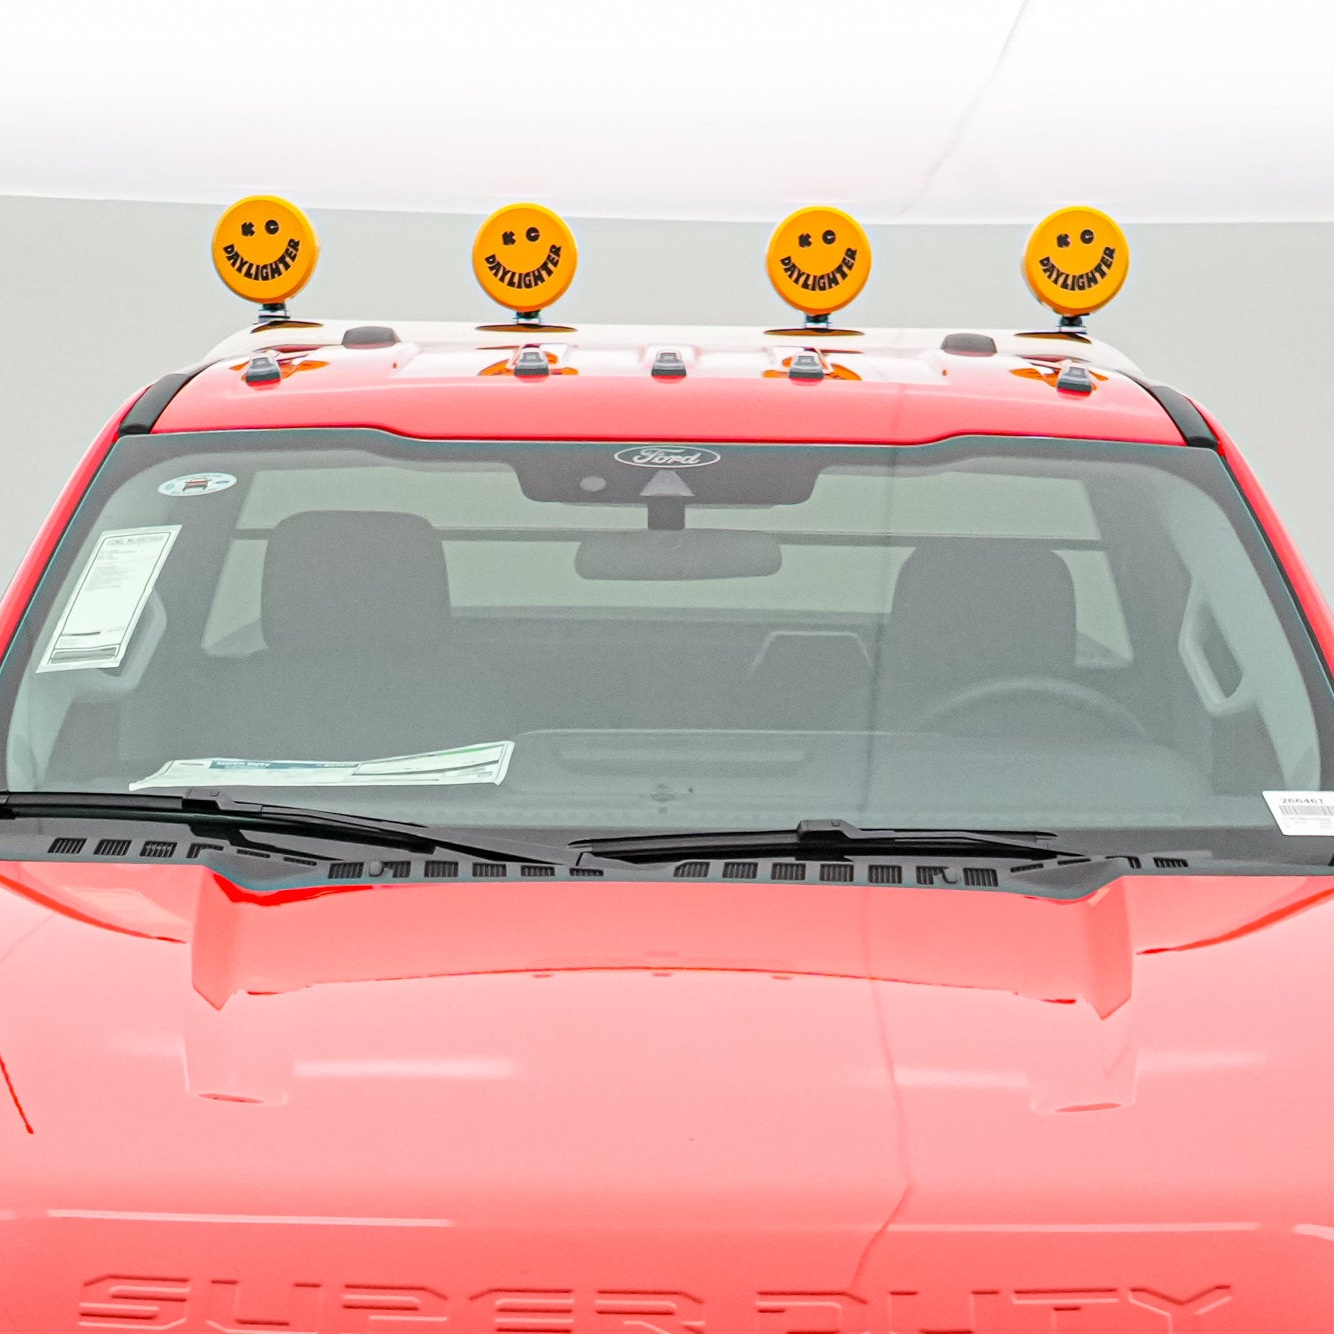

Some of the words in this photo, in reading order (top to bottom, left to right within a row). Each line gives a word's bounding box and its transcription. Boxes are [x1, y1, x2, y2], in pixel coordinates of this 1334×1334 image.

[223, 238, 301, 281] DAYLIGHTER
[484, 244, 562, 290] DAYLIGHTER
[780, 247, 857, 291] DAYLIGHTER
[1039, 246, 1116, 291] DAYLIGHTER
[633, 447, 701, 464] Ford
